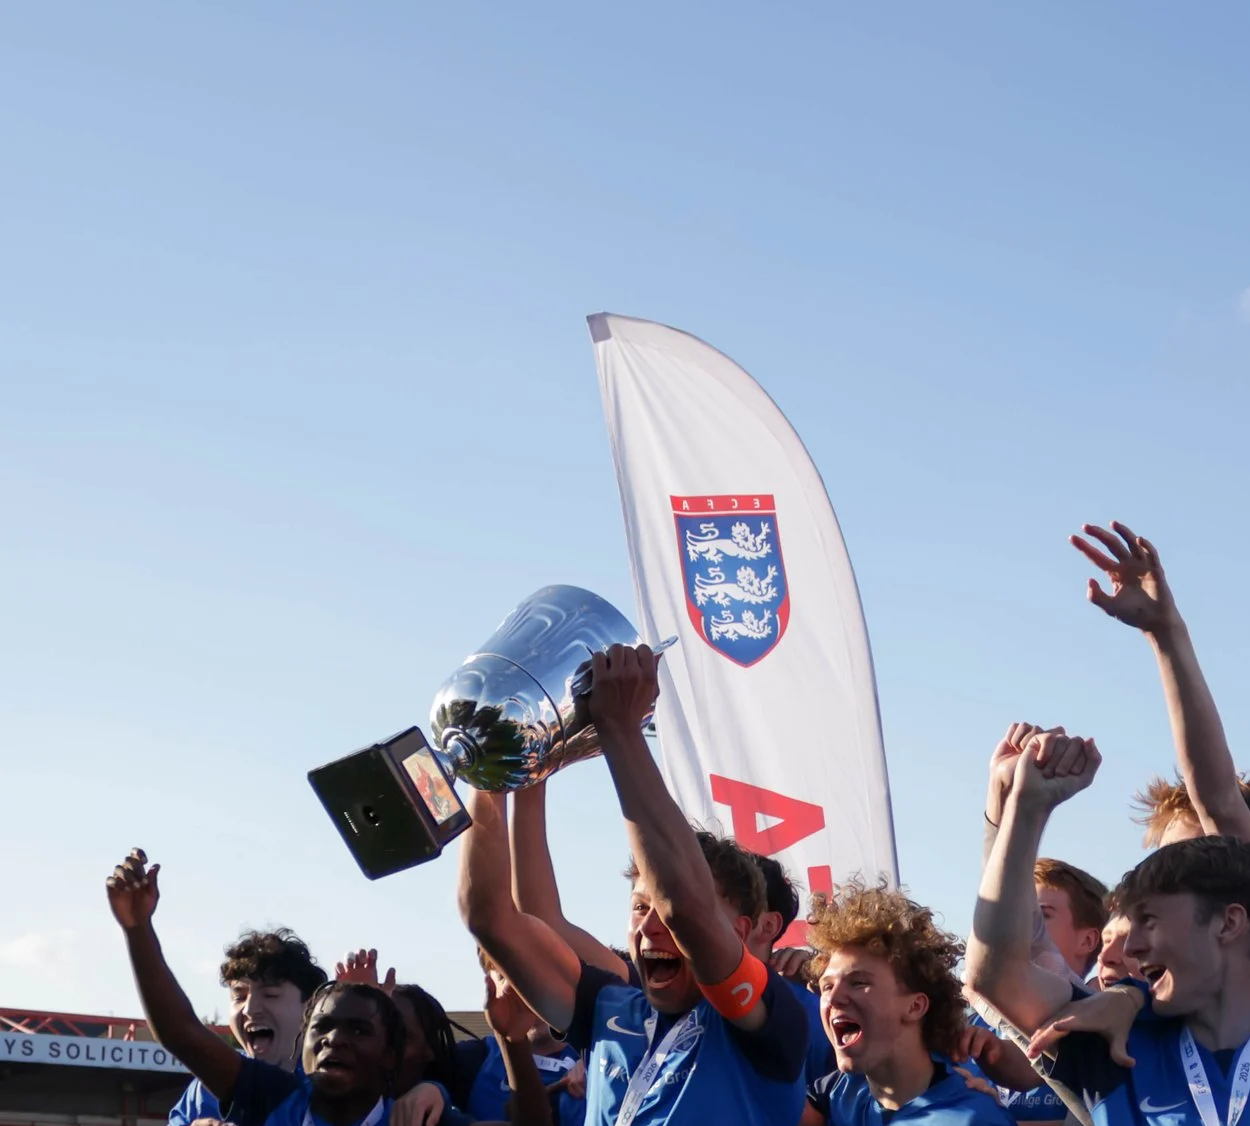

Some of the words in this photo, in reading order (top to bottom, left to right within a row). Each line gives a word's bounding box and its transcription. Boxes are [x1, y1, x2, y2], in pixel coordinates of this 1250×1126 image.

[48, 1042, 183, 1067] SOLICITO
[643, 1062, 658, 1084] 2026
[1238, 1062, 1250, 1082] 2026
